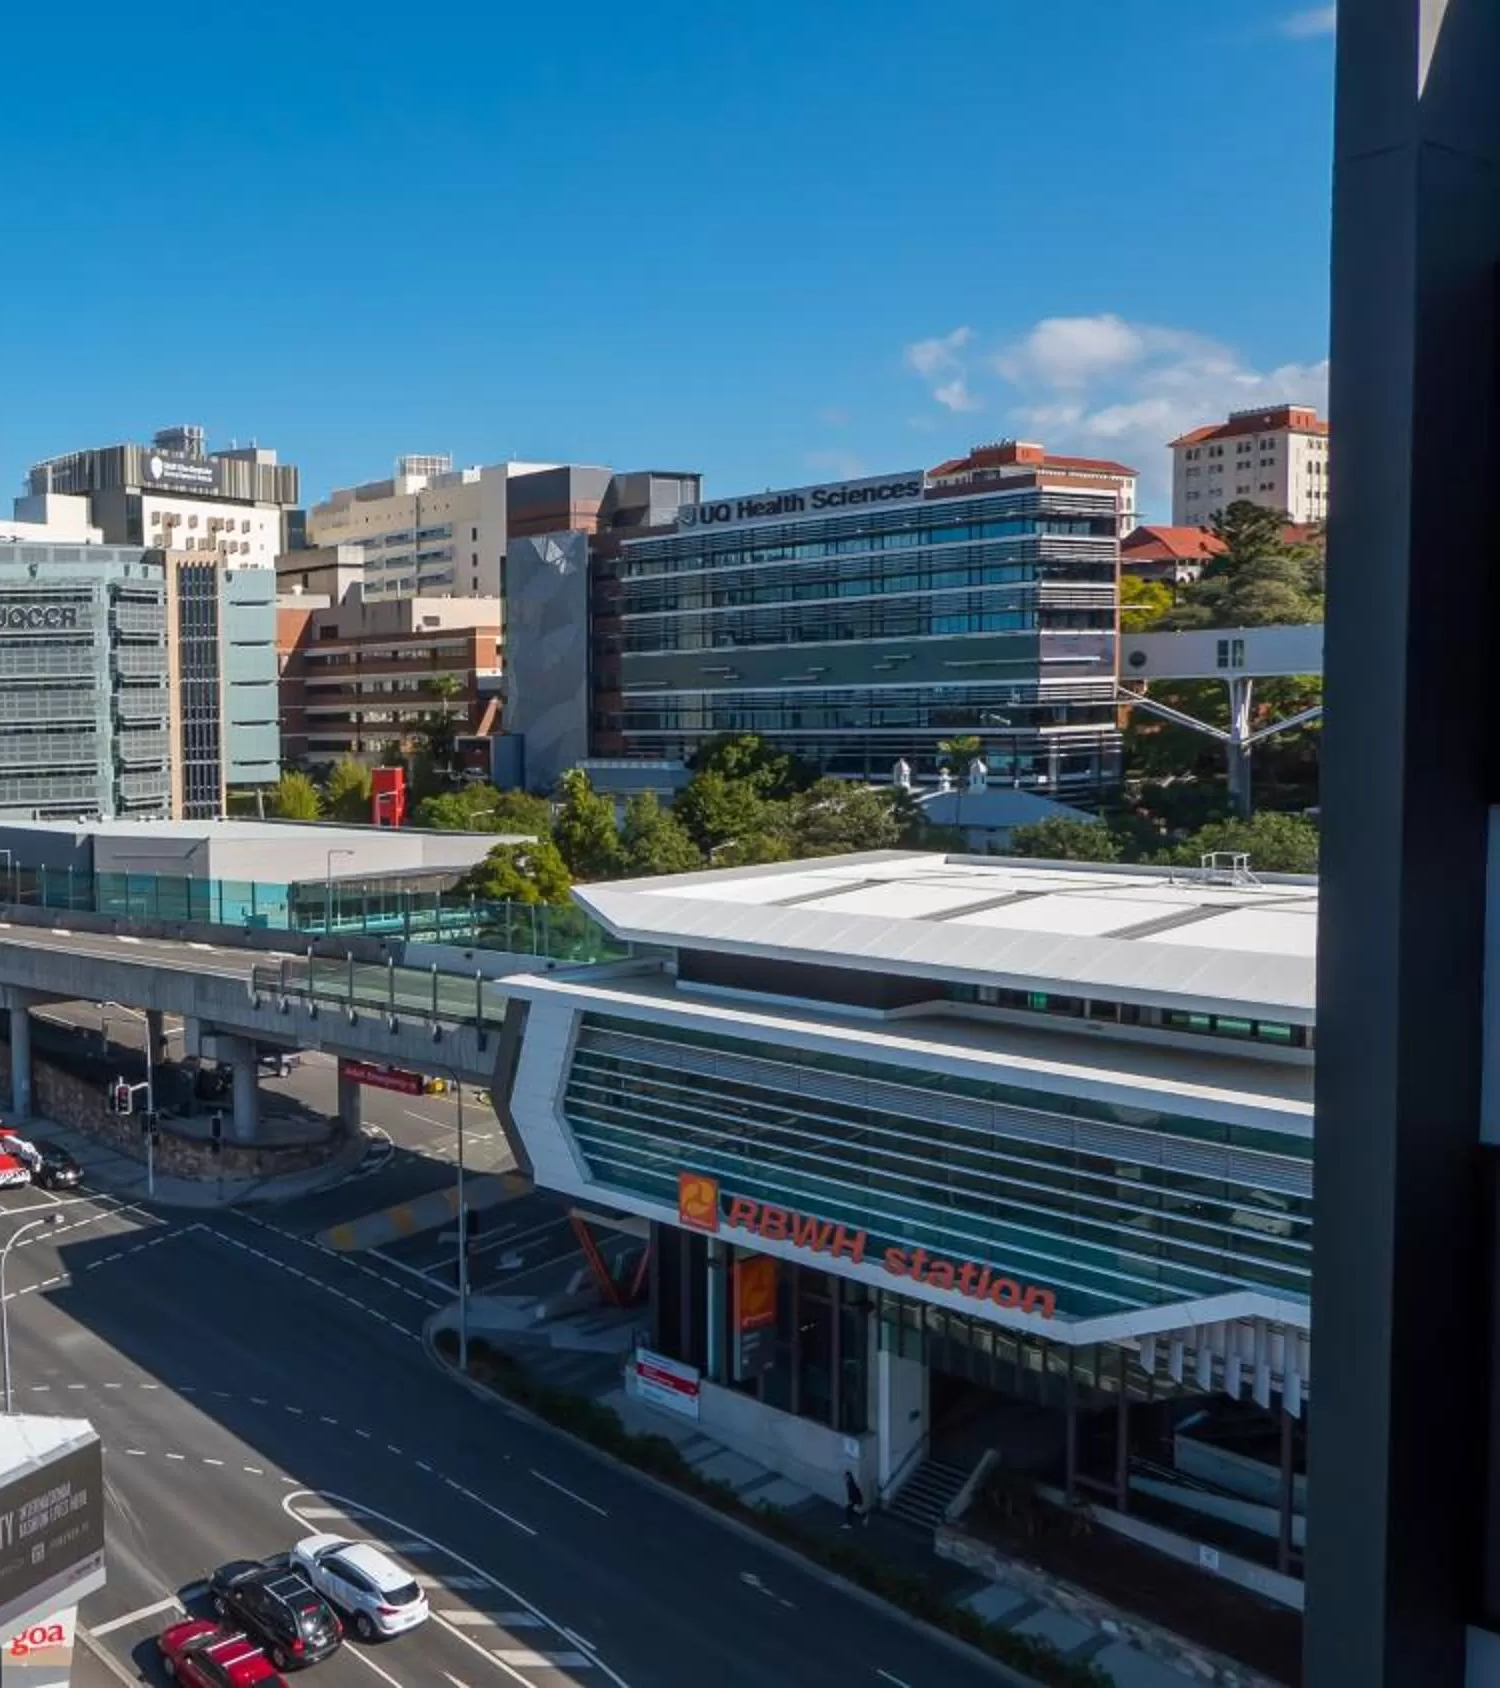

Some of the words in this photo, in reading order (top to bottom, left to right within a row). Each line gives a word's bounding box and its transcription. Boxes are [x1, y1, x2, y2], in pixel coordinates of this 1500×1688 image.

[700, 503, 731, 526] UQ
[737, 493, 805, 521] Health
[811, 480, 920, 510] Sciences
[729, 1197, 867, 1264] RBWH
[884, 1247, 1057, 1319] station
[11, 1623, 64, 1656] goa
